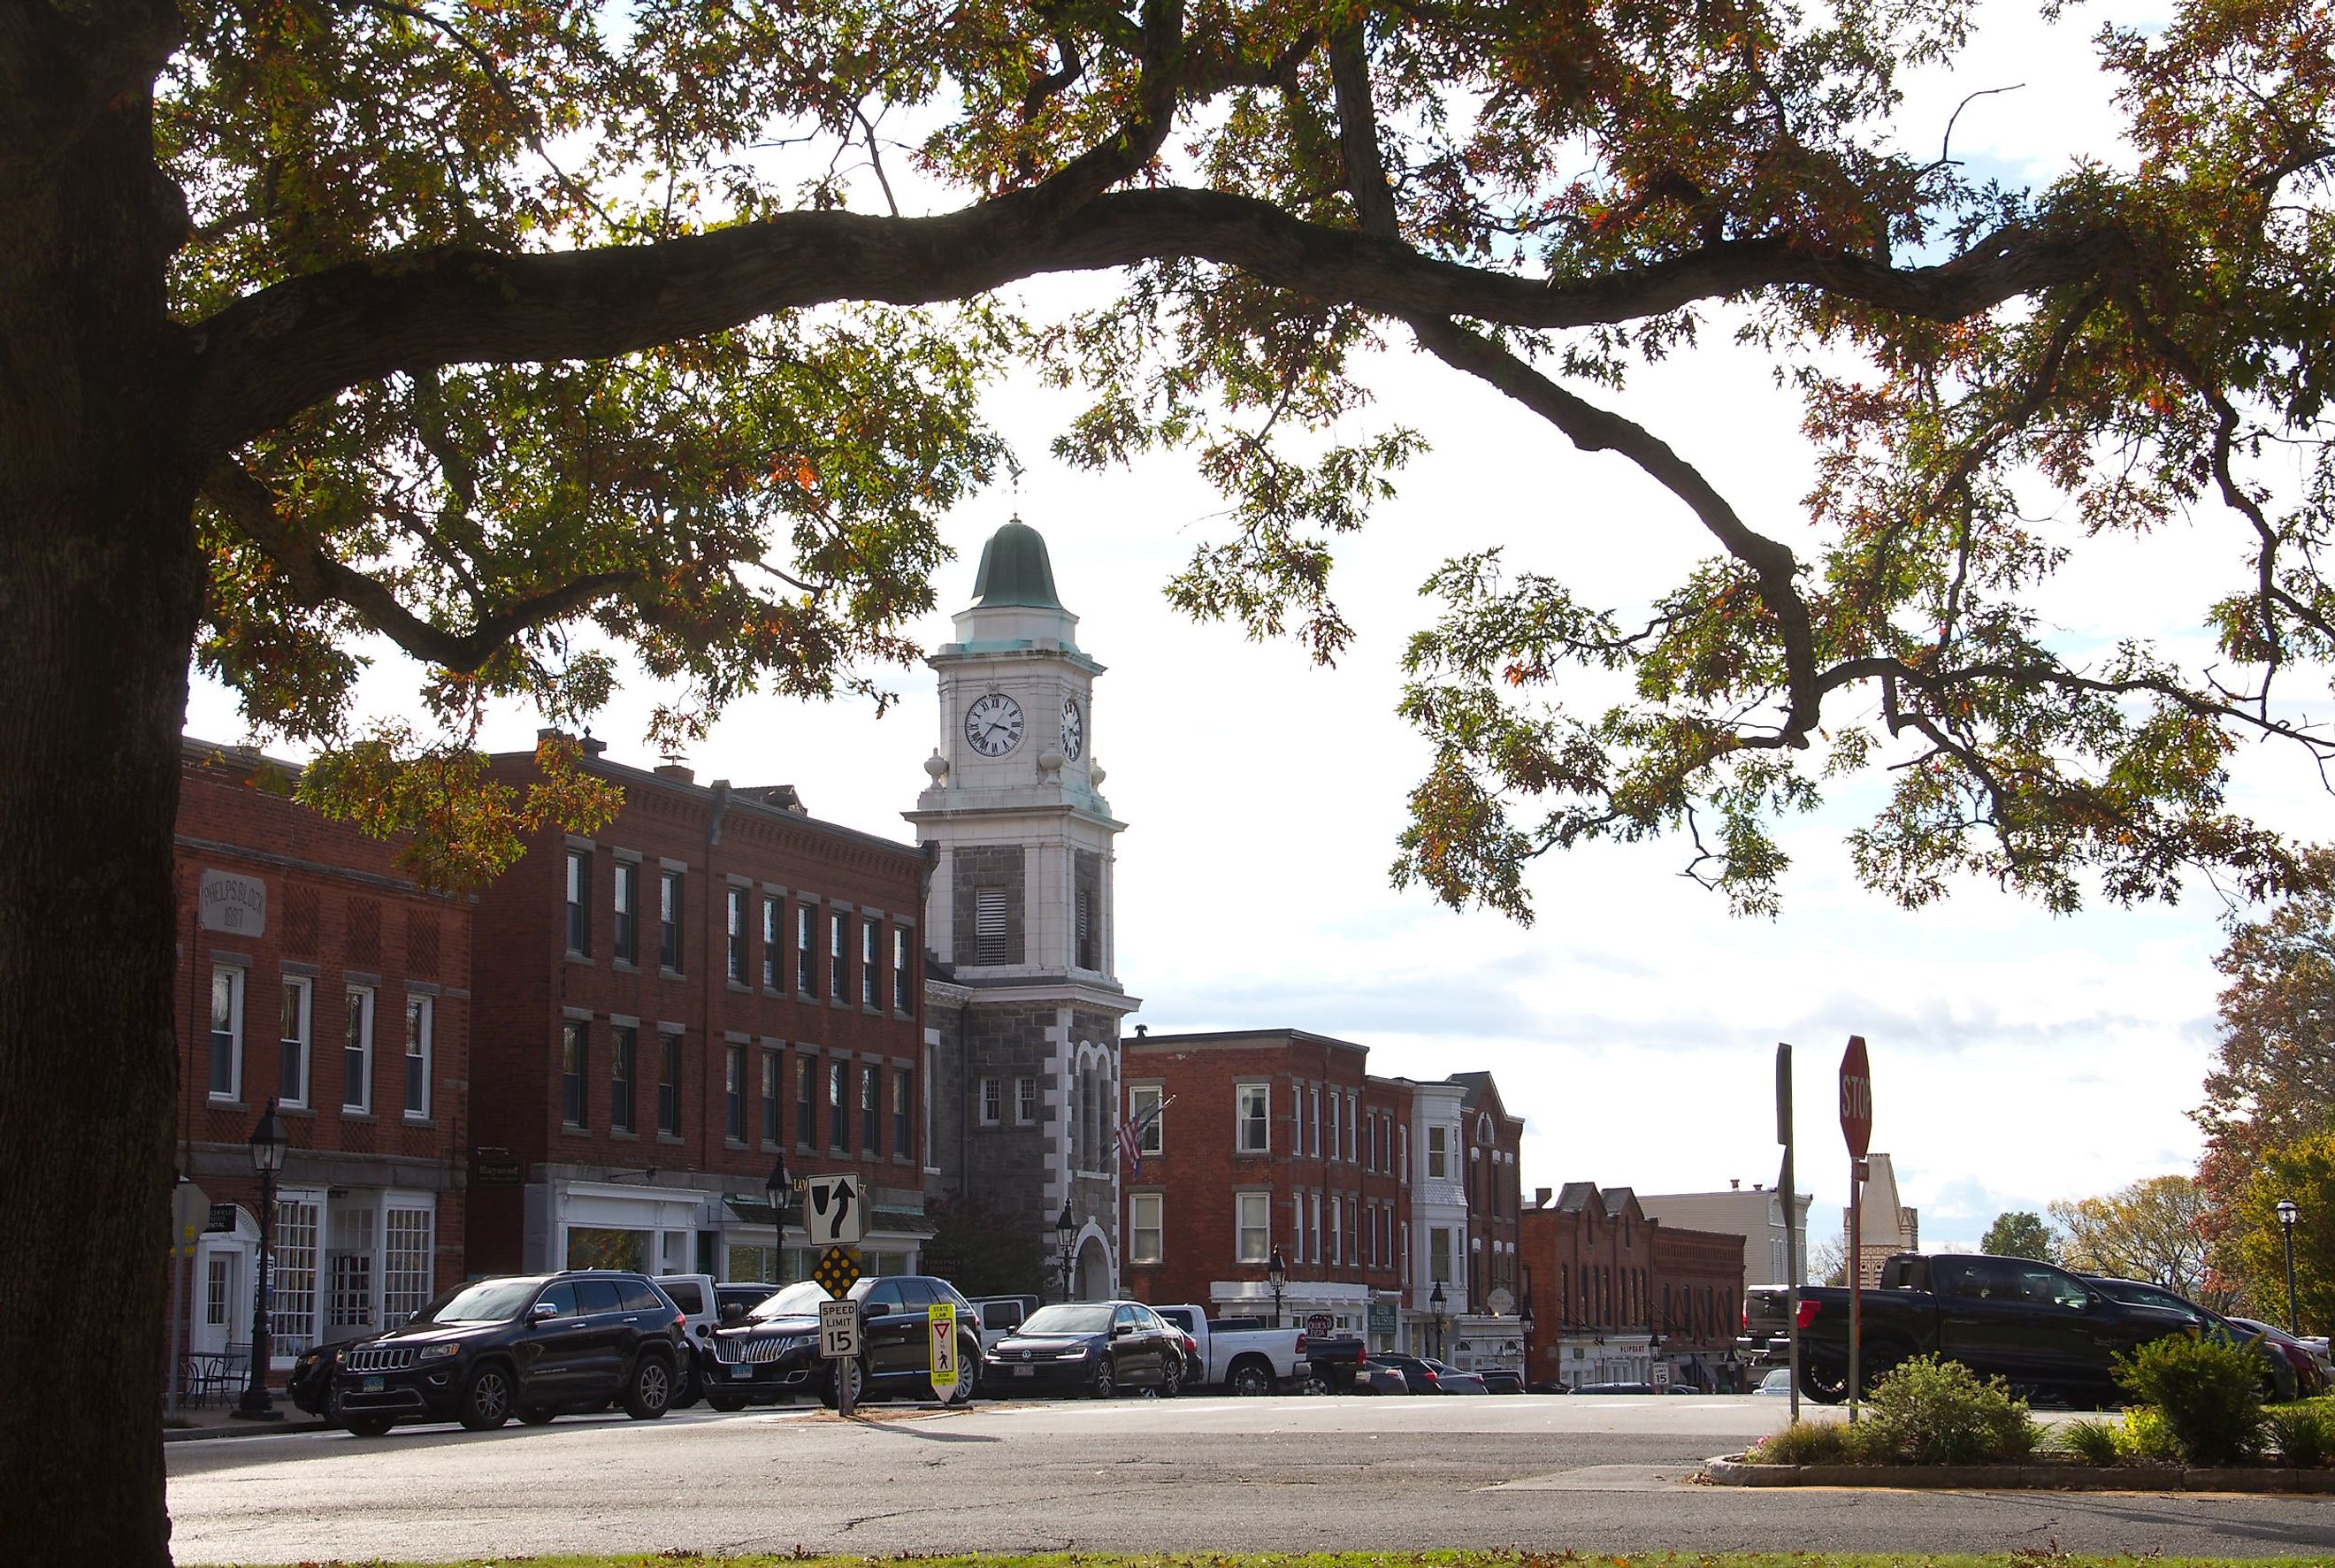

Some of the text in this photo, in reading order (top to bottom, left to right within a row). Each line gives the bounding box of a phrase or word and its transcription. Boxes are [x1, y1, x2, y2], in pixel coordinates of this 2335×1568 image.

[203, 880, 237, 906] PHELPS
[1842, 1075, 1871, 1121] STOP
[823, 1305, 855, 1316] SPEED
[826, 1318, 852, 1327] LIMIT
[828, 1330, 852, 1352] 15
[1657, 1373, 1667, 1383] 15
